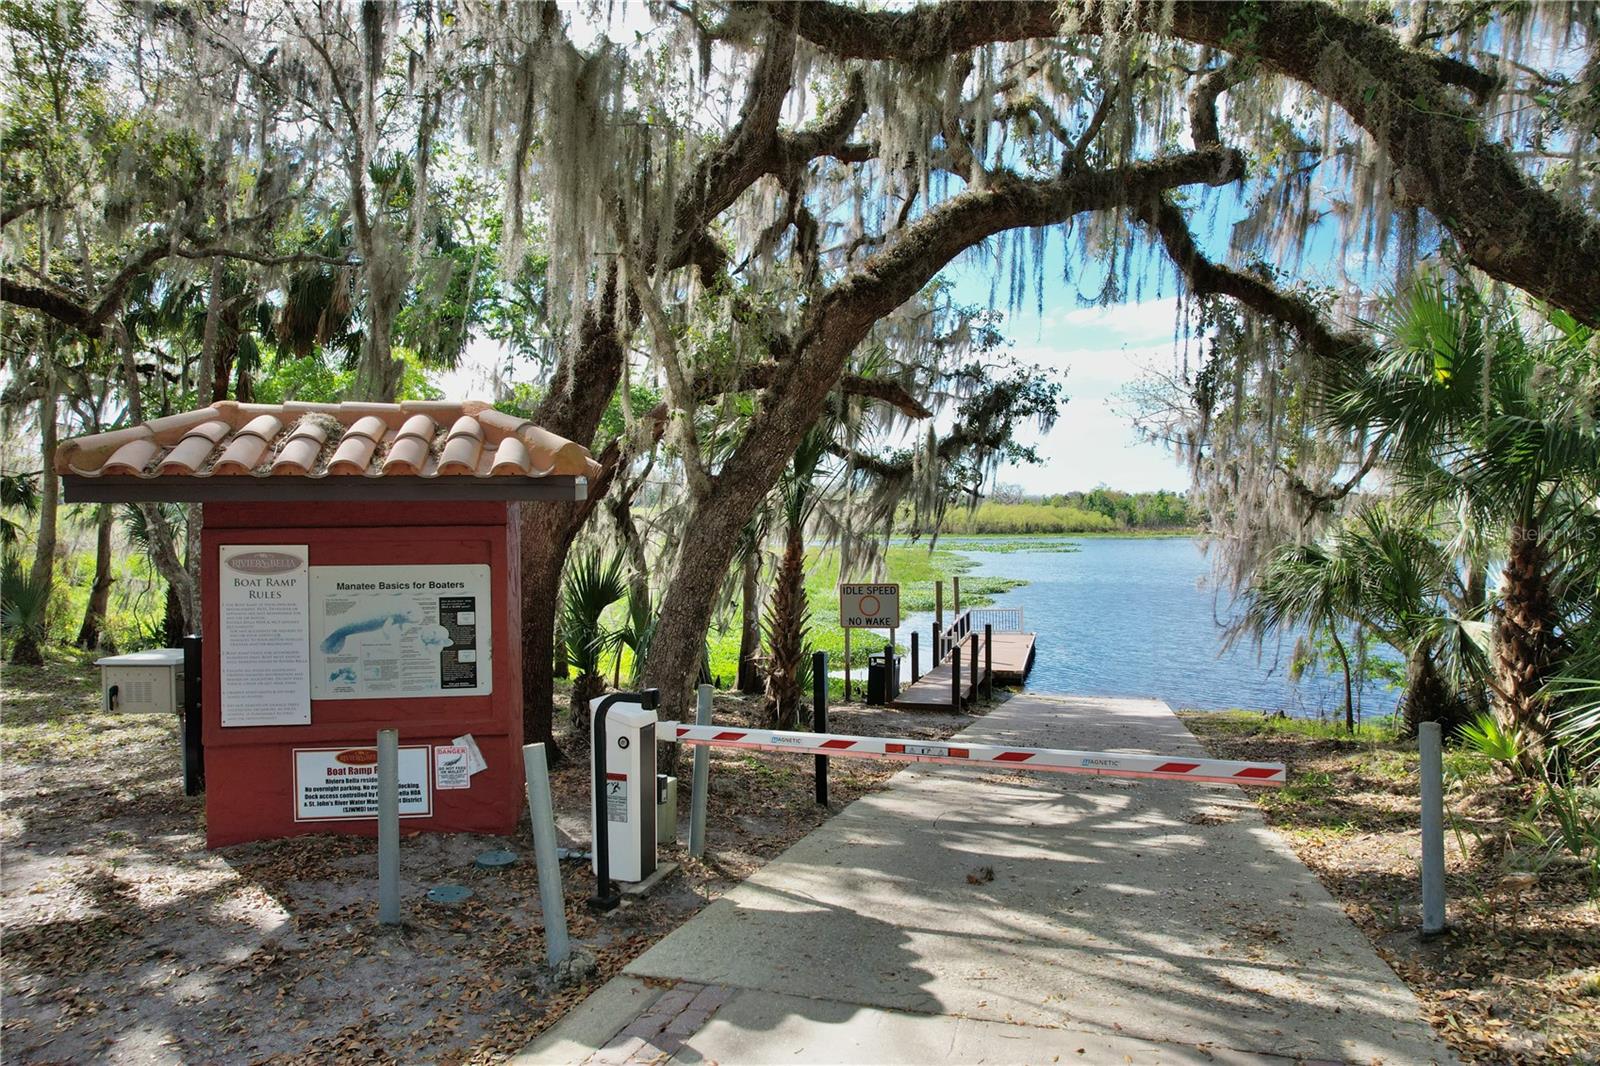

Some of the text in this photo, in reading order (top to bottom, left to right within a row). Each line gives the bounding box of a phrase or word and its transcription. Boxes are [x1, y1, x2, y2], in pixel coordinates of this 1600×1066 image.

[234, 578, 297, 587] BOAT RAMP
[336, 580, 465, 590] Manatee Basics for Boaters
[249, 590, 282, 599] RULES
[843, 586, 896, 595] IDLE SPEED
[848, 617, 891, 625] NO WAKE
[327, 767, 346, 776] Boat
[348, 766, 372, 776] Ramp
[313, 785, 339, 793] overnight
